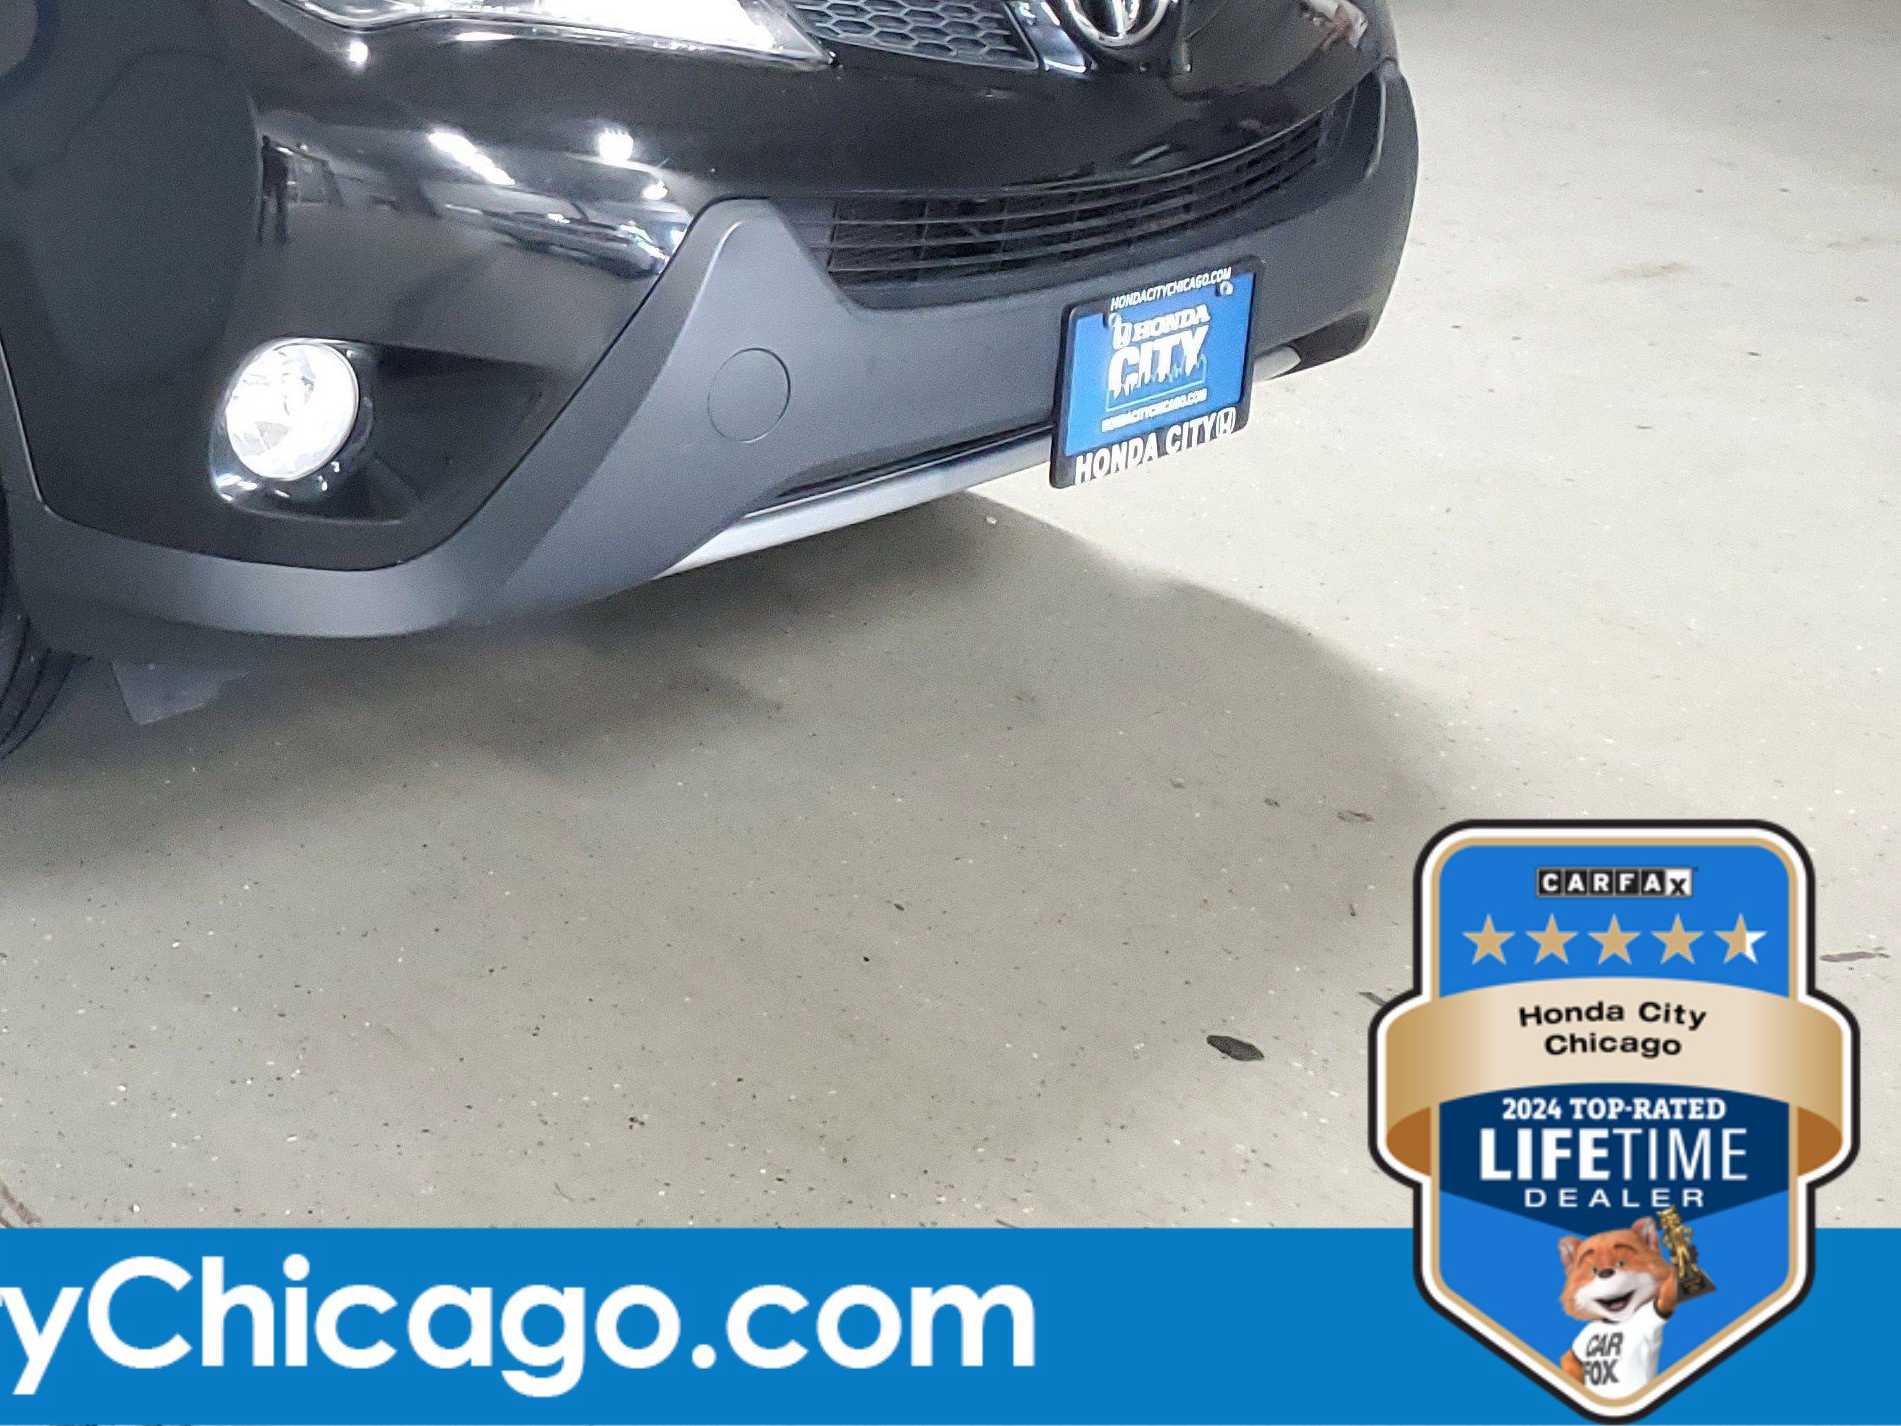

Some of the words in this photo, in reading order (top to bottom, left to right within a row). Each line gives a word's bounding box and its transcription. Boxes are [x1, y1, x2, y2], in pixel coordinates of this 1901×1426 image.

[1109, 267, 1233, 312] HONDACITYCHICAGO.COM
[1107, 324, 1211, 398] CITY
[1074, 432, 1160, 485] HONDA
[1165, 418, 1219, 454] CITY
